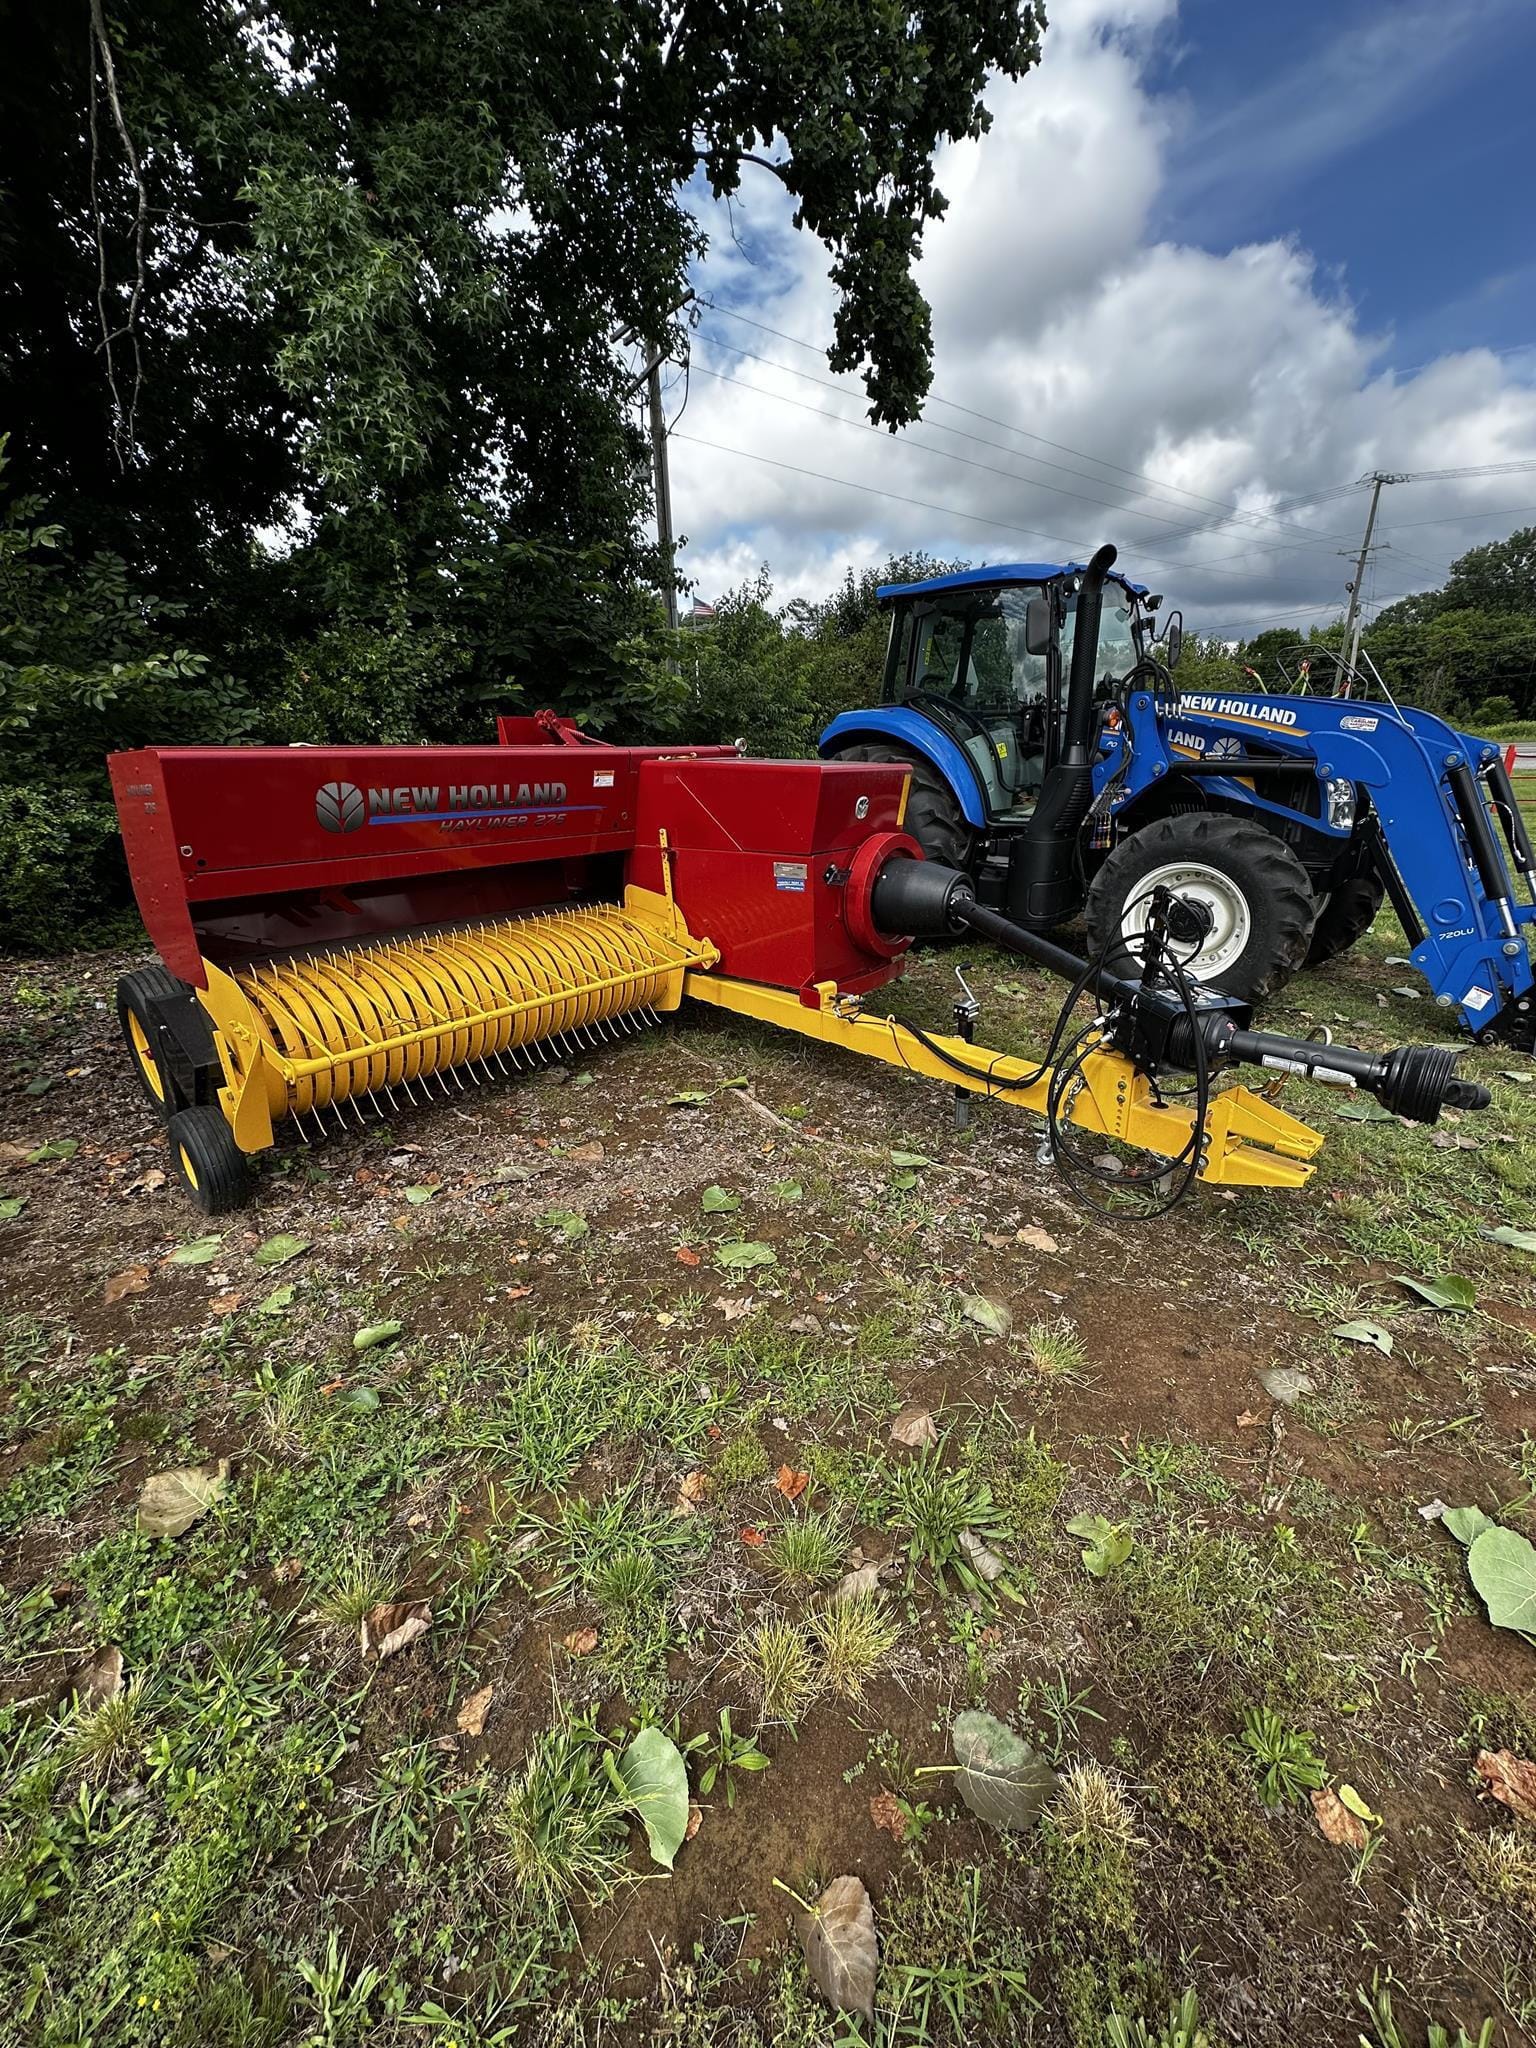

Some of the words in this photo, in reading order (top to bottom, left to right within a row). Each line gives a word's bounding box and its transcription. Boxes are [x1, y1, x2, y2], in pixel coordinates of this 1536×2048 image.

[1180, 694, 1217, 711] NEW
[1218, 698, 1297, 726] HOLLAND
[1167, 728, 1206, 751] LAND
[368, 786, 439, 815] NEW
[448, 782, 567, 810] HOLLAND
[439, 815, 528, 833] HAYLINER
[534, 813, 567, 827] 275
[1438, 927, 1475, 941] 720LU
